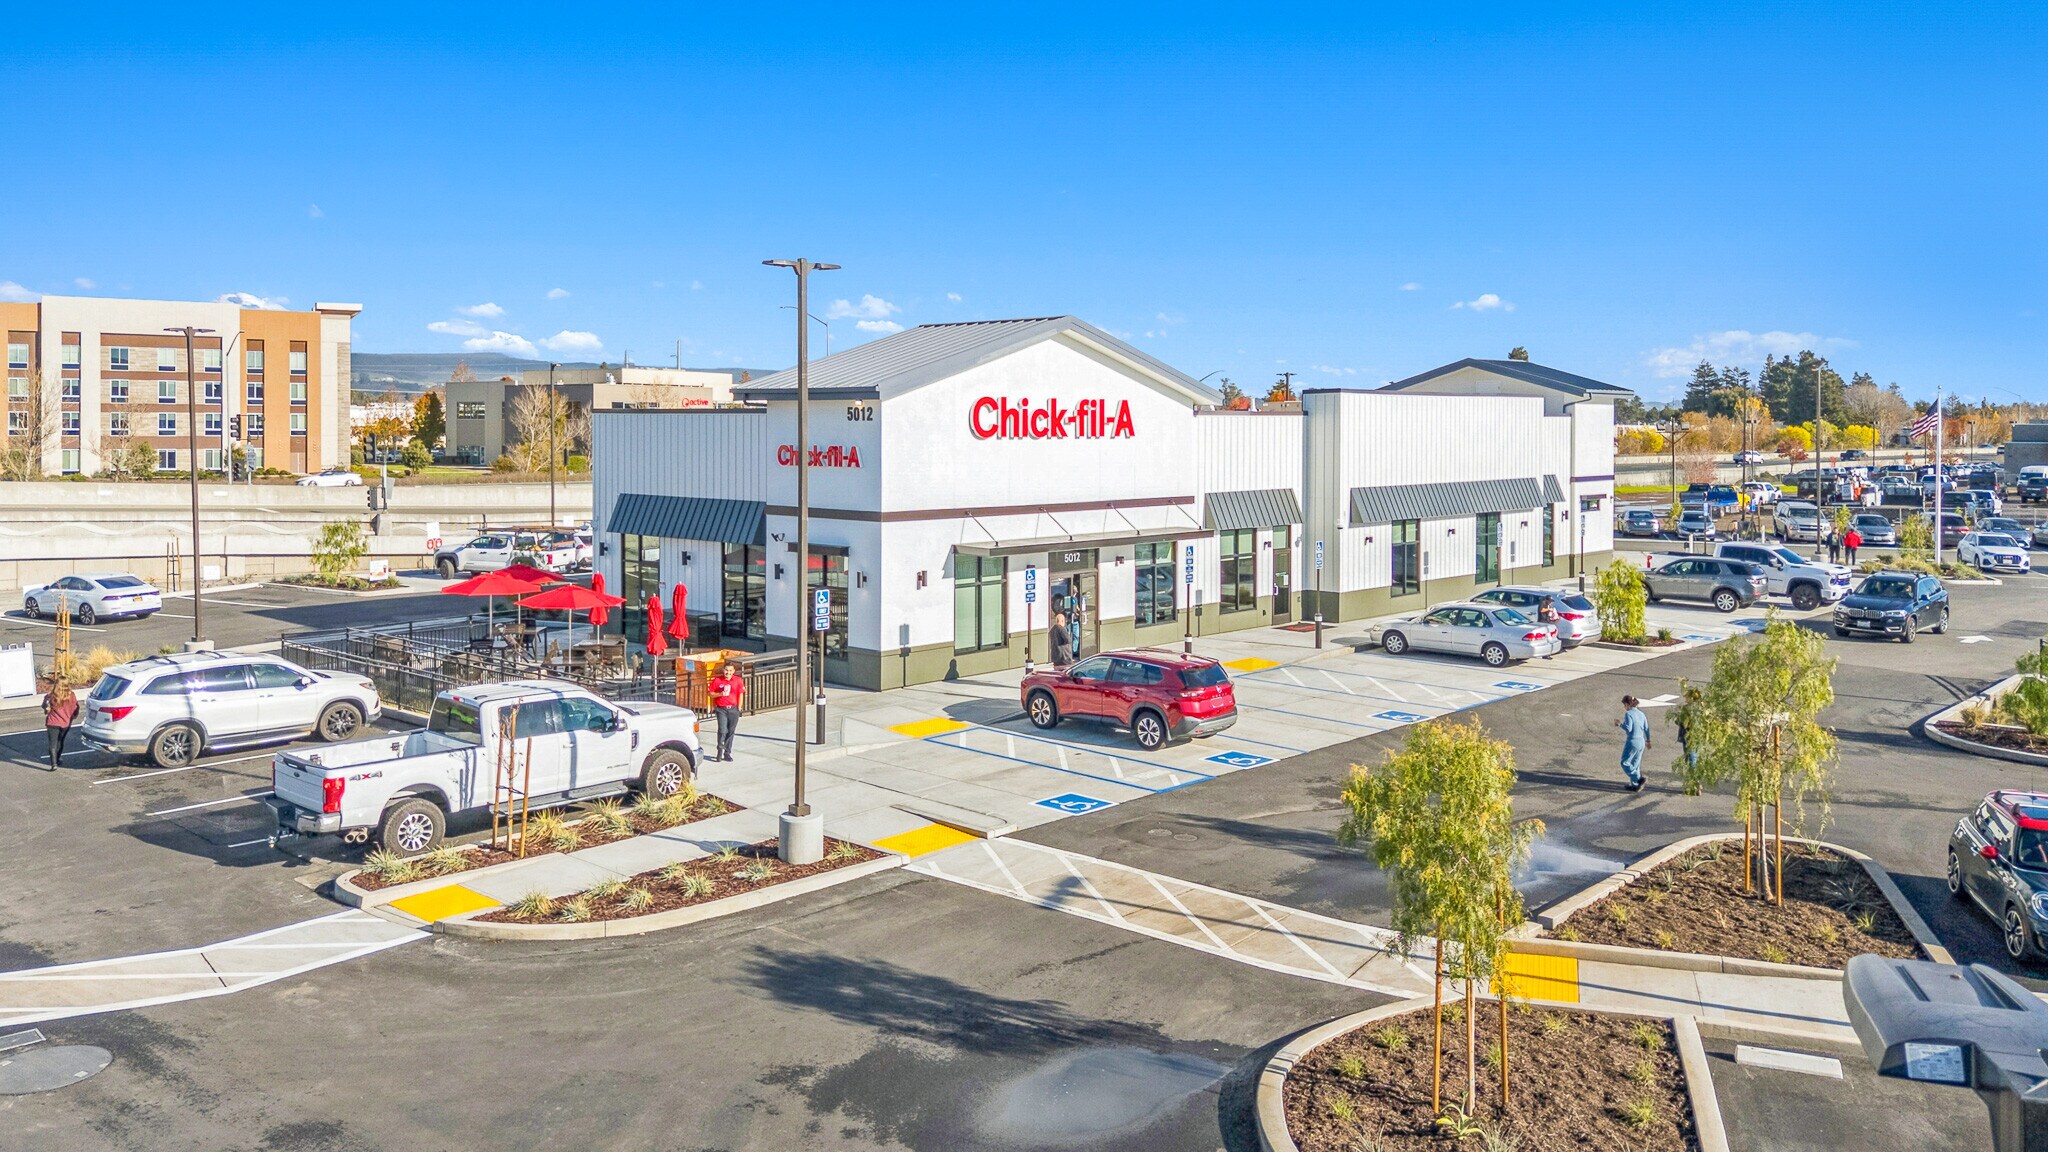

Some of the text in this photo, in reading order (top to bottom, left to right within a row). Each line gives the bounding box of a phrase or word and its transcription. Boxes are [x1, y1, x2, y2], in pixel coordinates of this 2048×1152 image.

[847, 407, 873, 421] 5012
[970, 397, 1135, 439] Chick-fil-A
[777, 445, 860, 467] Chck-fil-A
[1064, 553, 1080, 562] 5012
